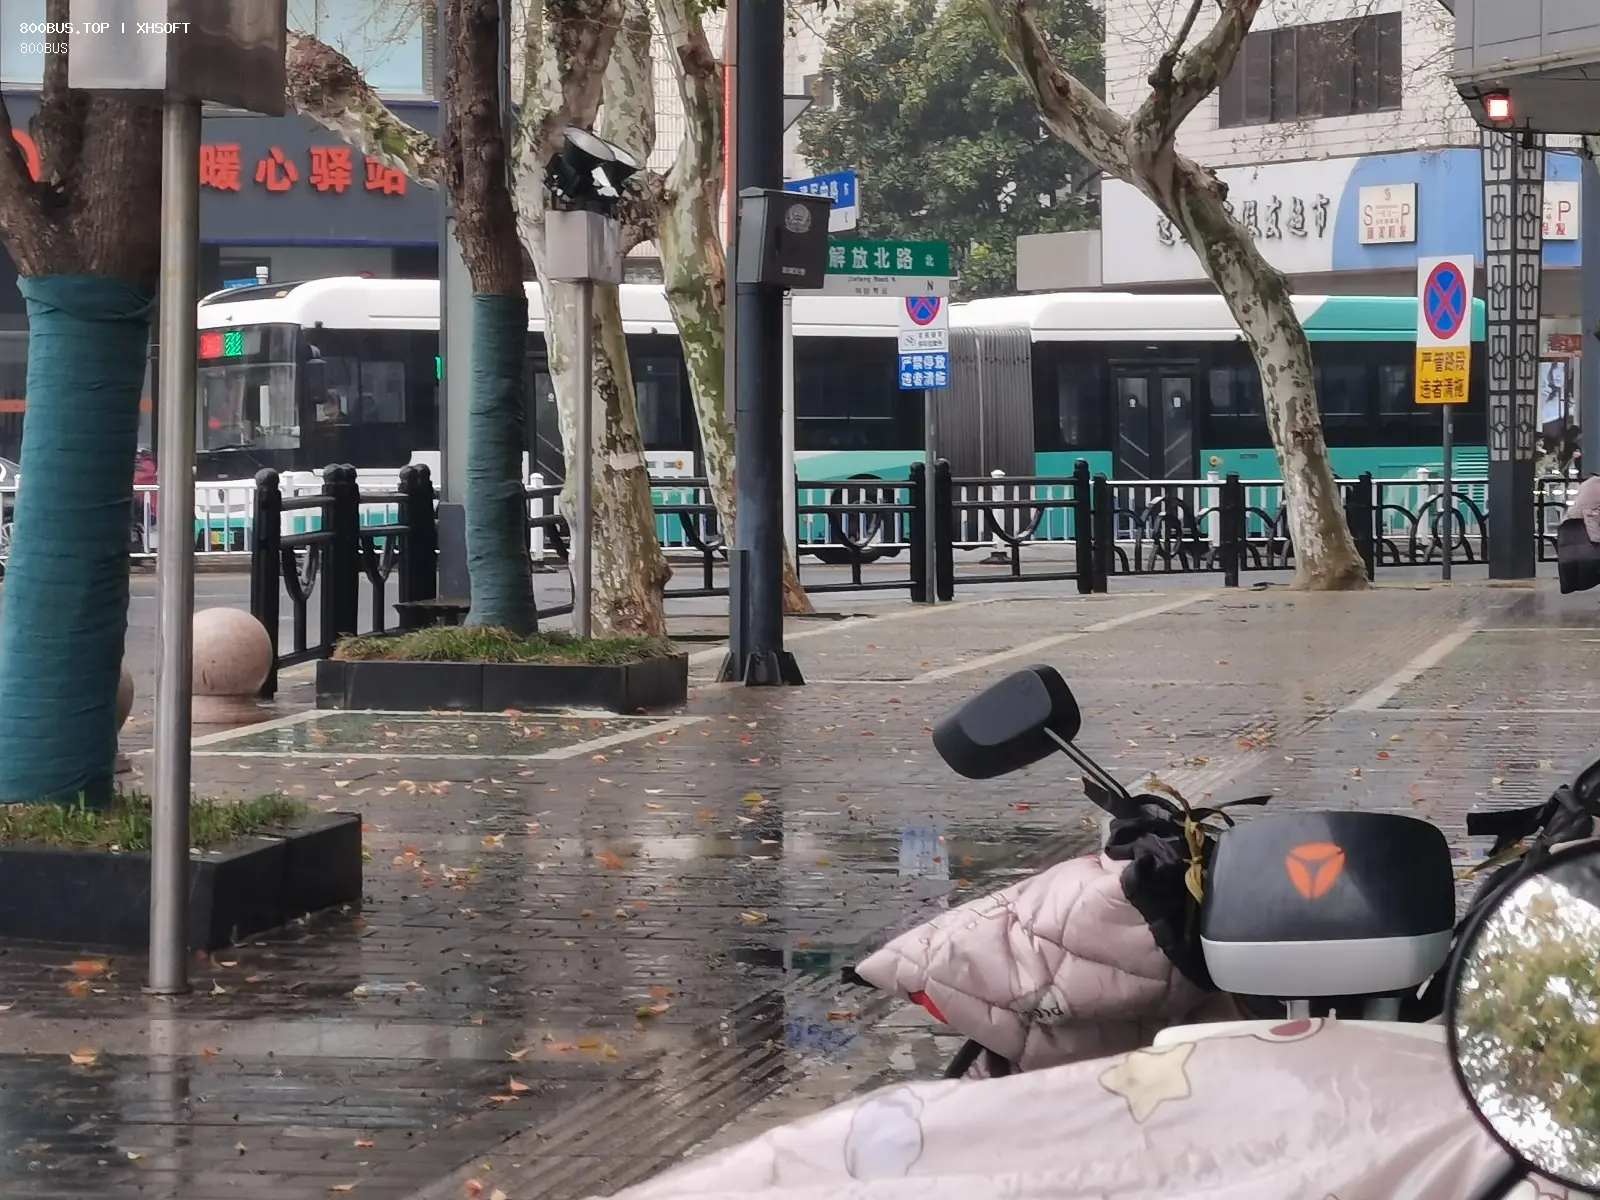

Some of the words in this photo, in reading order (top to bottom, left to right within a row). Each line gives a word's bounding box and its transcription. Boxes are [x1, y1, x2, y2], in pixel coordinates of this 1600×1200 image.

[199, 144, 407, 195] 暖心驿站
[829, 246, 913, 270] 解放北路
[925, 254, 934, 267] 北
[927, 280, 934, 291] N
[901, 355, 946, 371] 严禁停放
[1421, 351, 1466, 372] 严管路段
